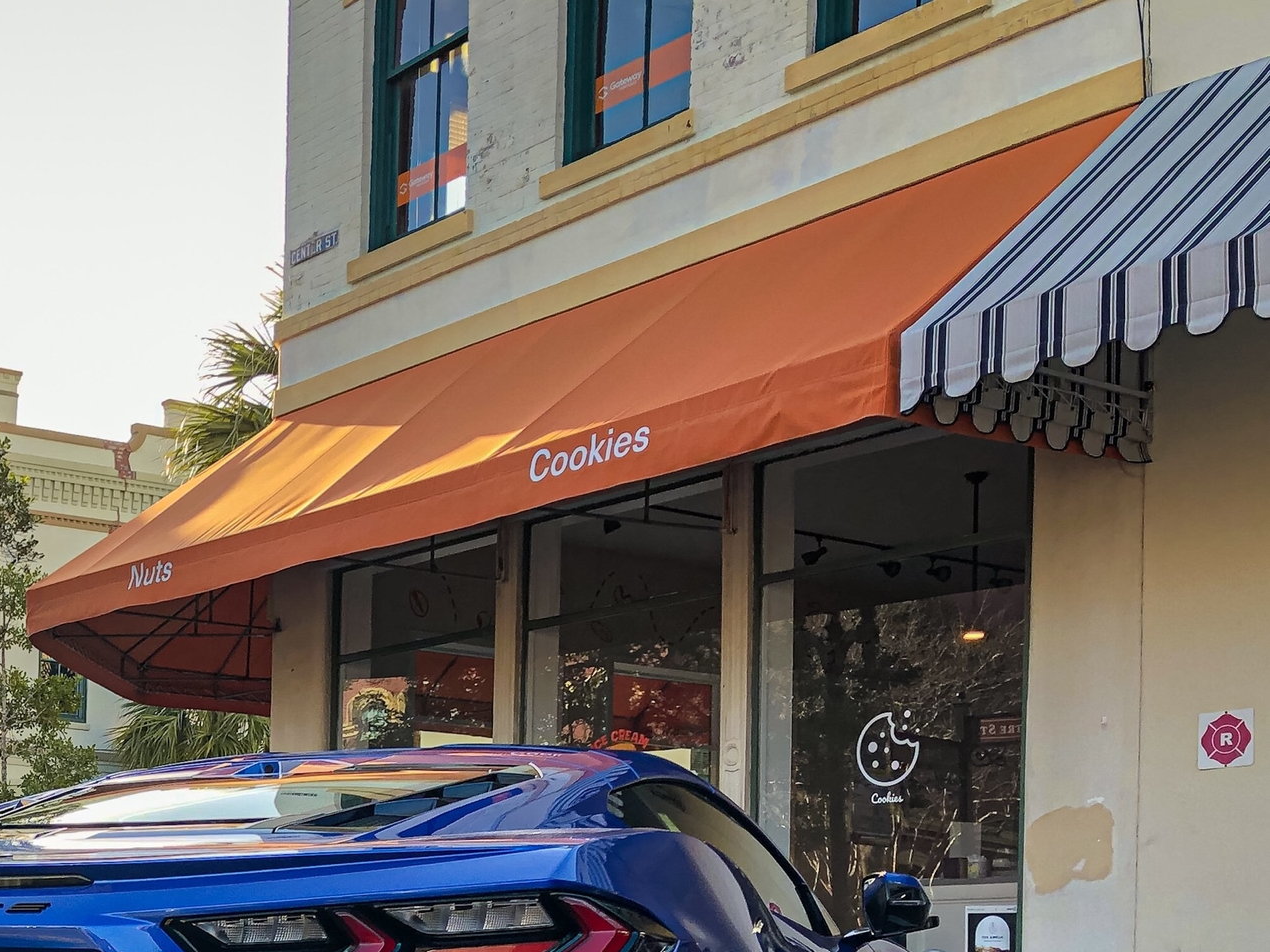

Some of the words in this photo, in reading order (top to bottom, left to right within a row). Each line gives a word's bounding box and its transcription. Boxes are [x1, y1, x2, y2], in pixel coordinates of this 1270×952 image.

[610, 70, 642, 91] Gateway
[291, 239, 322, 265] CENTR
[529, 425, 651, 482] Cookies
[127, 559, 173, 590] Nuts
[611, 728, 650, 749] CREAM
[1220, 732, 1233, 747] R
[871, 790, 904, 804] Cookies
